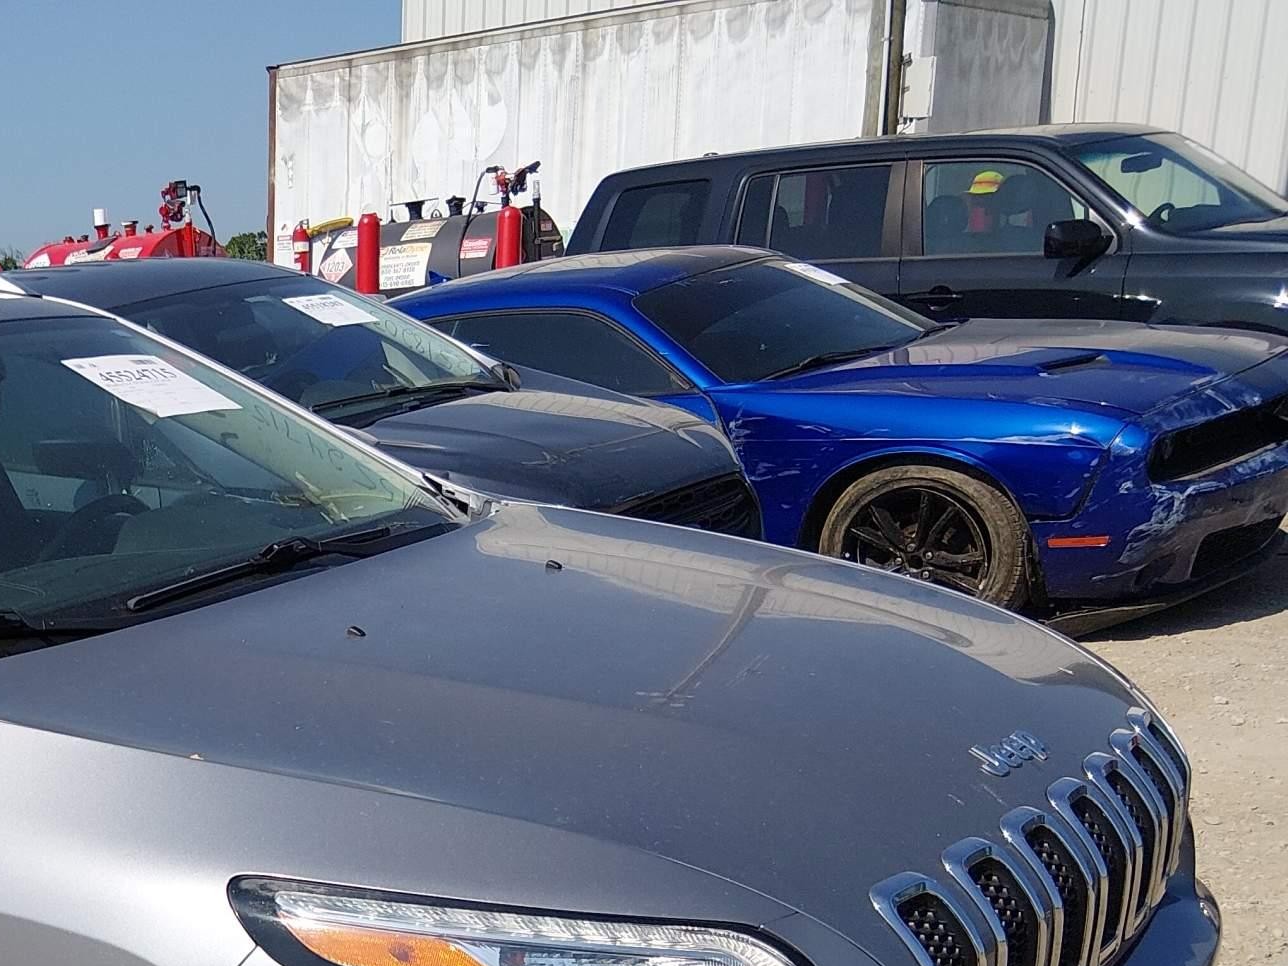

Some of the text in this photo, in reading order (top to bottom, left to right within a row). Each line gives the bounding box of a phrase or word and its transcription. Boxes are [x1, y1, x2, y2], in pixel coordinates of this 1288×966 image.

[326, 260, 346, 273] 1203
[98, 367, 178, 384] 45524715
[968, 730, 1048, 777] Jeep
